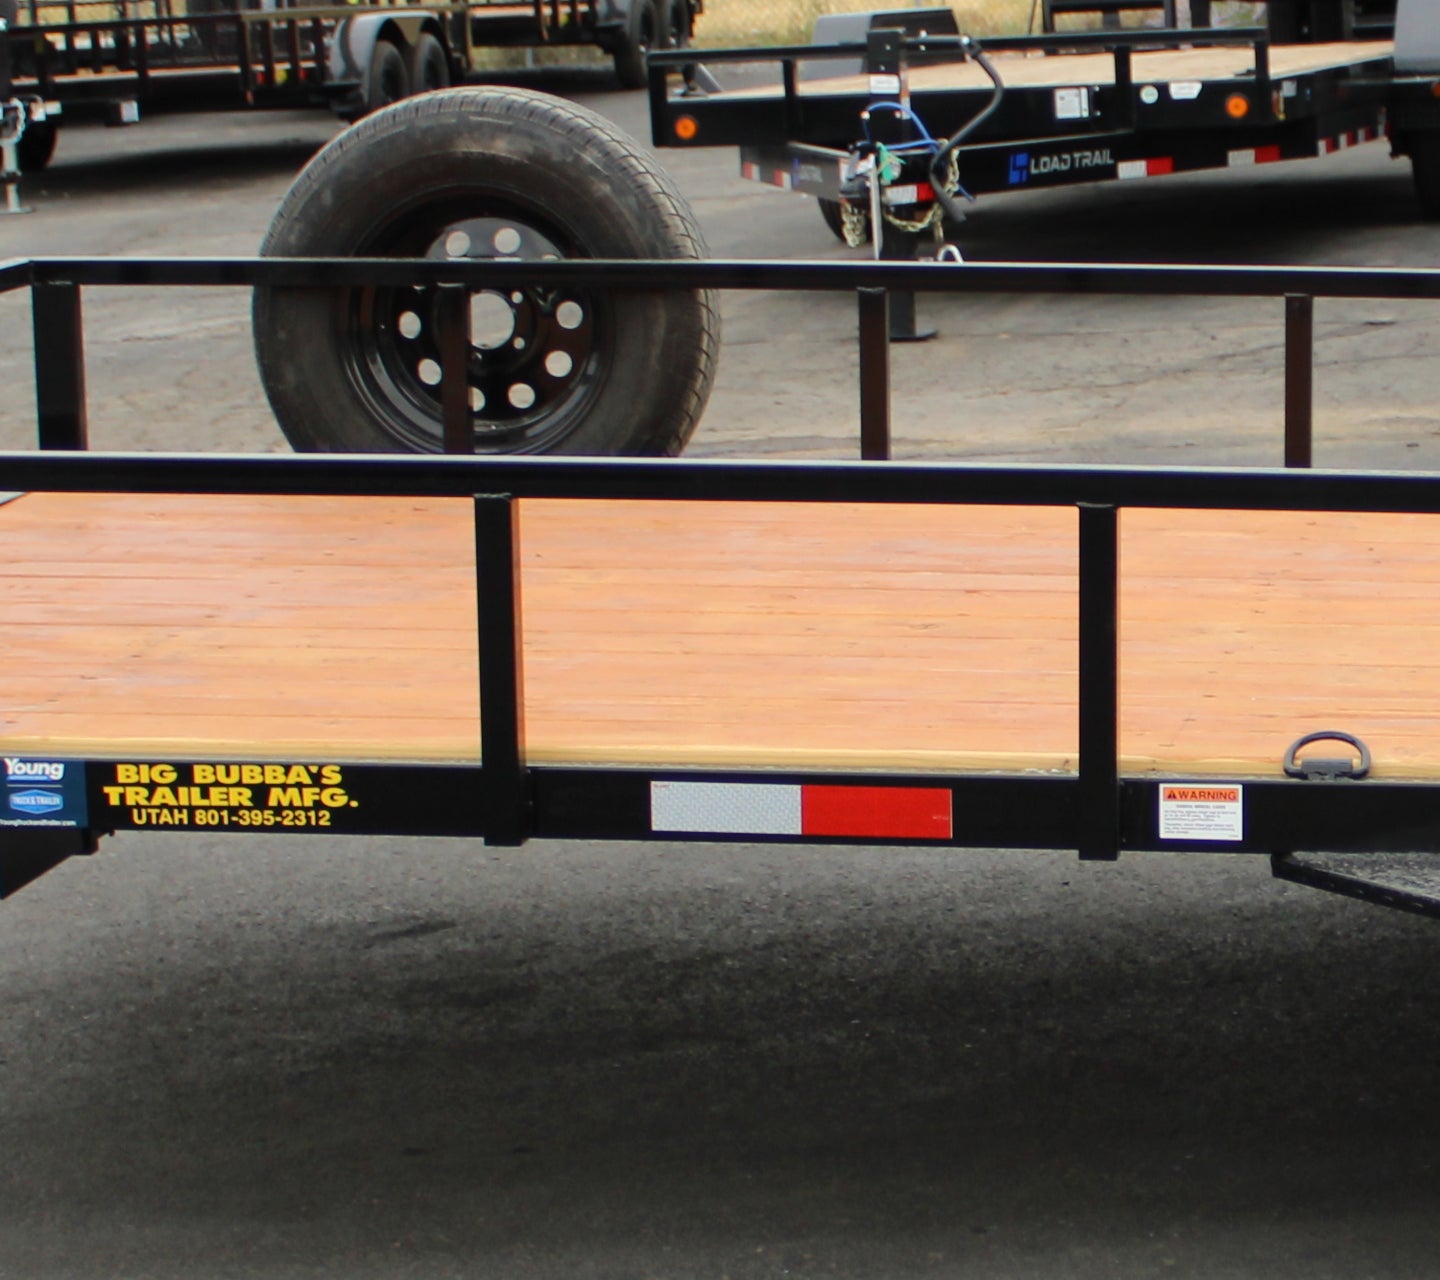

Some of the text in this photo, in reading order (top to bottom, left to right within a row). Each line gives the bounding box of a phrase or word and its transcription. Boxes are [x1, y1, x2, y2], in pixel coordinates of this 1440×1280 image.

[1030, 149, 1115, 175] LOAD TRAIL
[3, 757, 65, 781] Young
[116, 763, 343, 786] BIG BUBBA'S
[103, 786, 360, 808] TRAILER MFG.
[1177, 790, 1237, 801] WARNING
[132, 808, 332, 827] UTAH 801-395-2312
